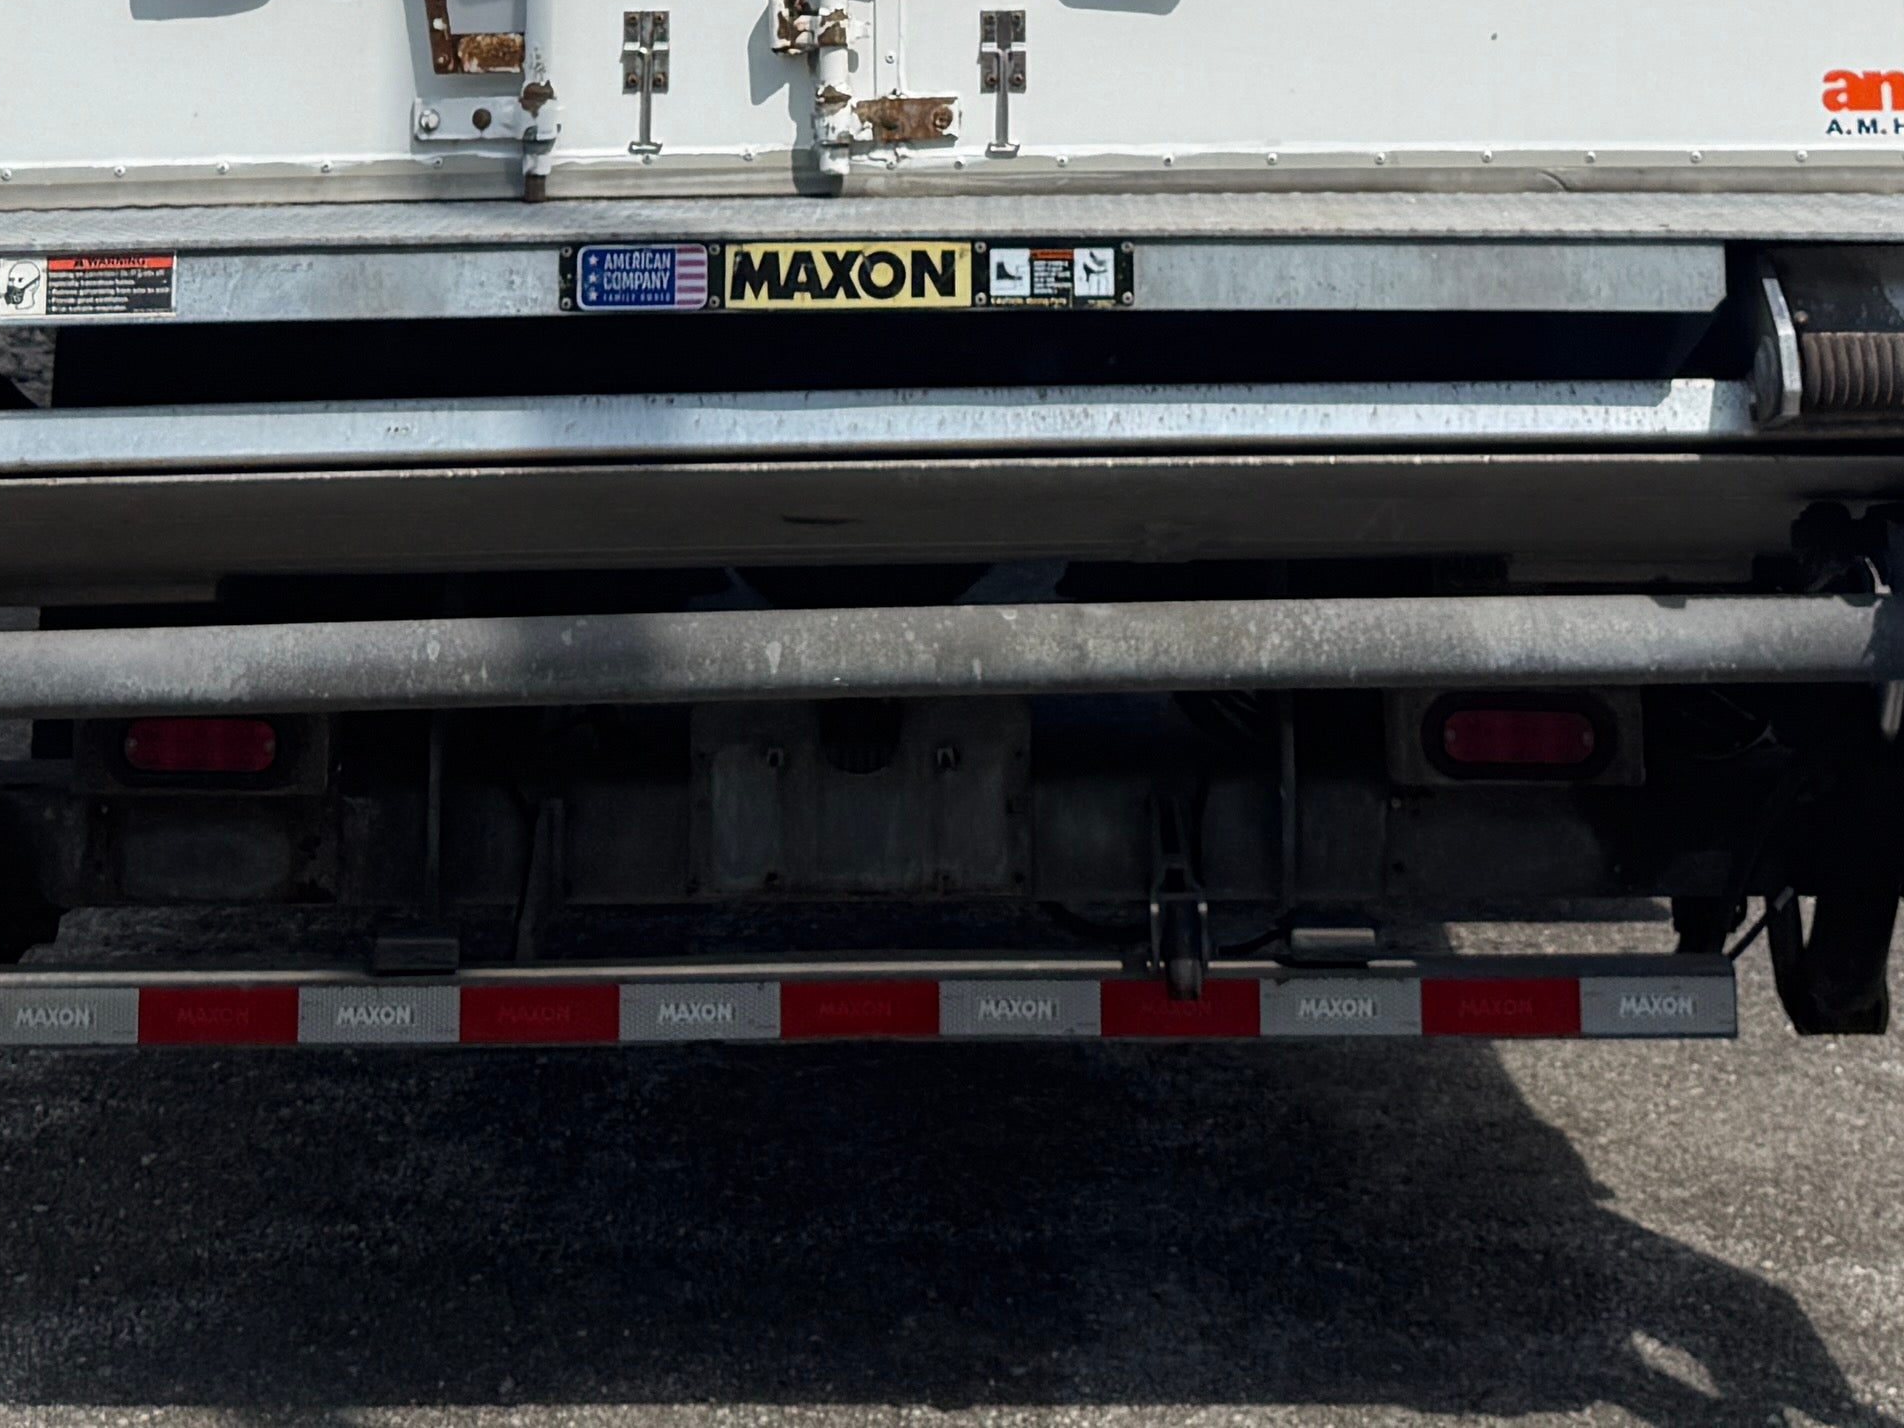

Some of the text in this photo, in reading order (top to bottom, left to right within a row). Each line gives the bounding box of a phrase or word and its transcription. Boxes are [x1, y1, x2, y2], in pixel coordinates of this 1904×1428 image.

[604, 251, 671, 270] AMERICAN
[603, 271, 670, 290] COMPANY
[730, 249, 956, 301] MAXON
[336, 1005, 413, 1027] MAXON
[657, 1002, 734, 1023] MAXON
[977, 999, 1054, 1021] MAXON
[1298, 997, 1374, 1018] MAXON
[1619, 995, 1695, 1018] MAXON
[16, 1007, 91, 1029] MAXON
